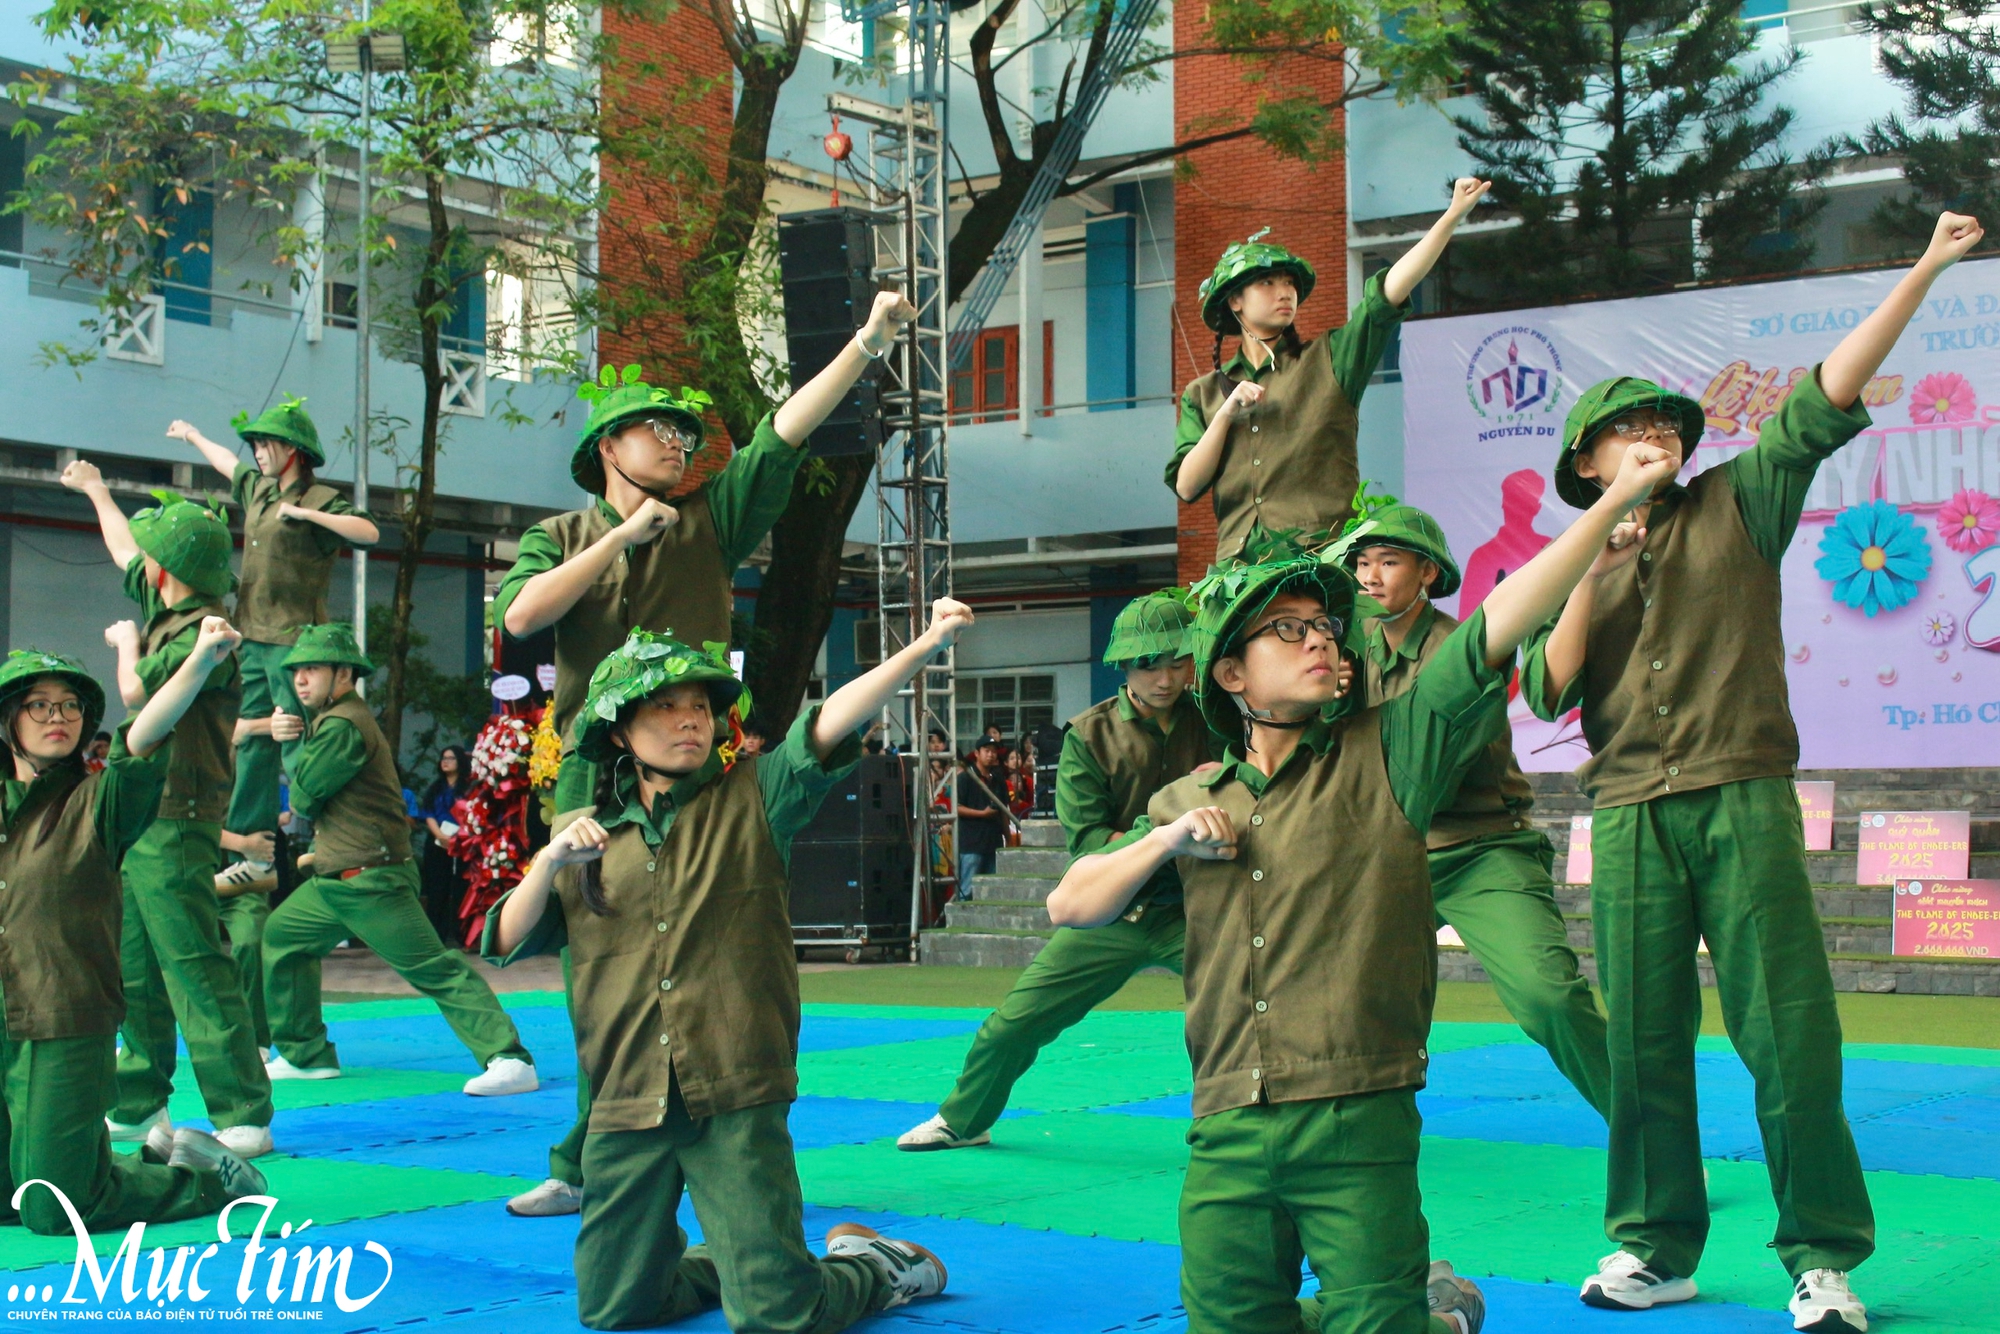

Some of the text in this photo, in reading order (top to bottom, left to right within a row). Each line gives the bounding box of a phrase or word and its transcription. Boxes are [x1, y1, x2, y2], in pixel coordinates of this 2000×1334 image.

[1790, 306, 1860, 334] GIÁO
[1497, 413, 1534, 423] 1971
[1536, 426, 1556, 437] DU
[1860, 842, 1876, 850] THE
[1889, 852, 1934, 869] 2025
[1897, 909, 2000, 921] THE FLAME OF ENDEE-E
[1926, 921, 1975, 940] 2025
[1965, 946, 1989, 956] VND
